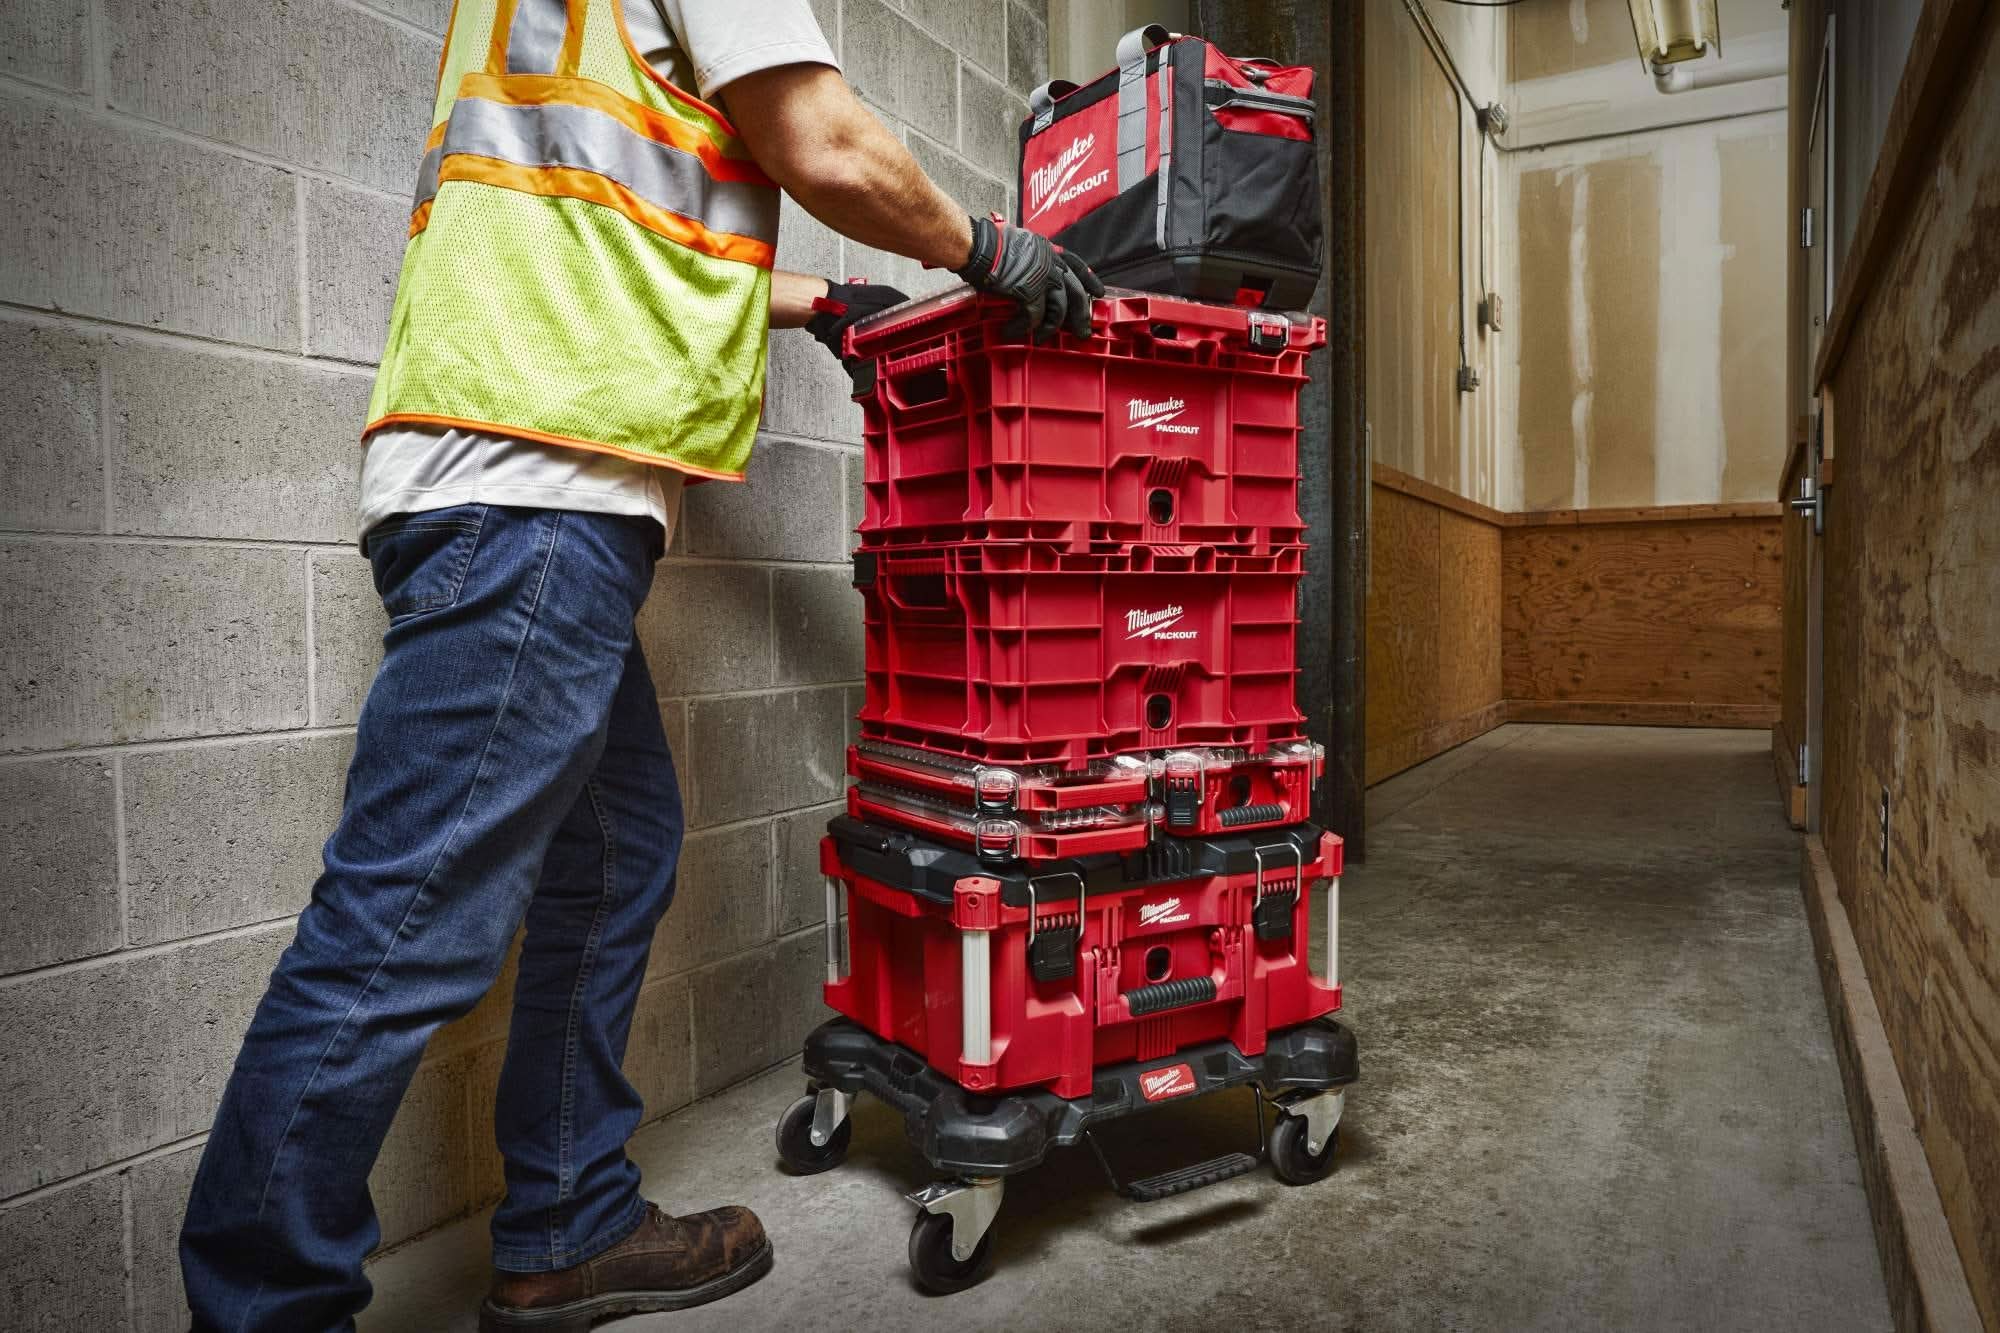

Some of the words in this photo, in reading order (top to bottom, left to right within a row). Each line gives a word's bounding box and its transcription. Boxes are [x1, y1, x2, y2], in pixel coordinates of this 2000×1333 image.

[1027, 132, 1096, 210] Milwaukee
[1058, 168, 1110, 207] PACKOUT
[1125, 396, 1185, 421] Milwaukee
[1156, 424, 1200, 435] PACKOUT
[1124, 604, 1184, 632] Milwaukee
[1154, 631, 1198, 640] PACKOUT
[1138, 897, 1181, 921] Milwaukee
[1144, 1068, 1181, 1094] Milwaukee
[1166, 1082, 1196, 1094] PACKOUT
